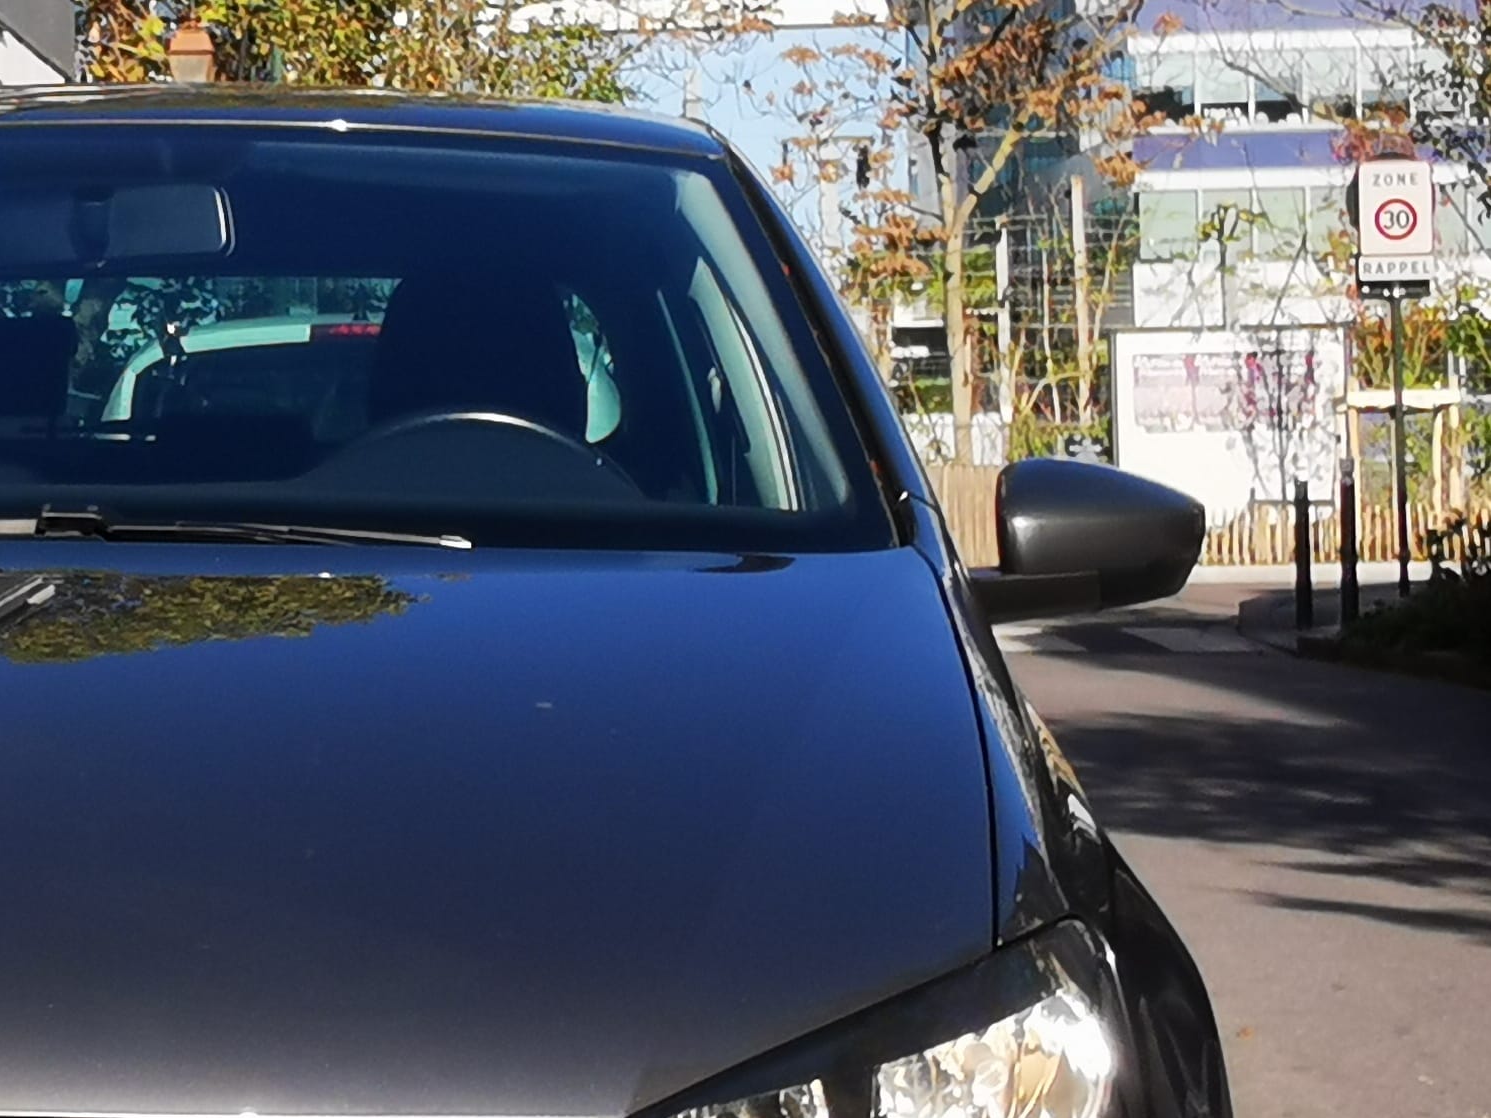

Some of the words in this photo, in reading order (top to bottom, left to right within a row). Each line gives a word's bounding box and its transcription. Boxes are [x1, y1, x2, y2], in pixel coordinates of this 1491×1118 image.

[1372, 172, 1419, 187] ZONE
[1382, 209, 1410, 230] 30
[1362, 261, 1431, 275] RAPPEL
